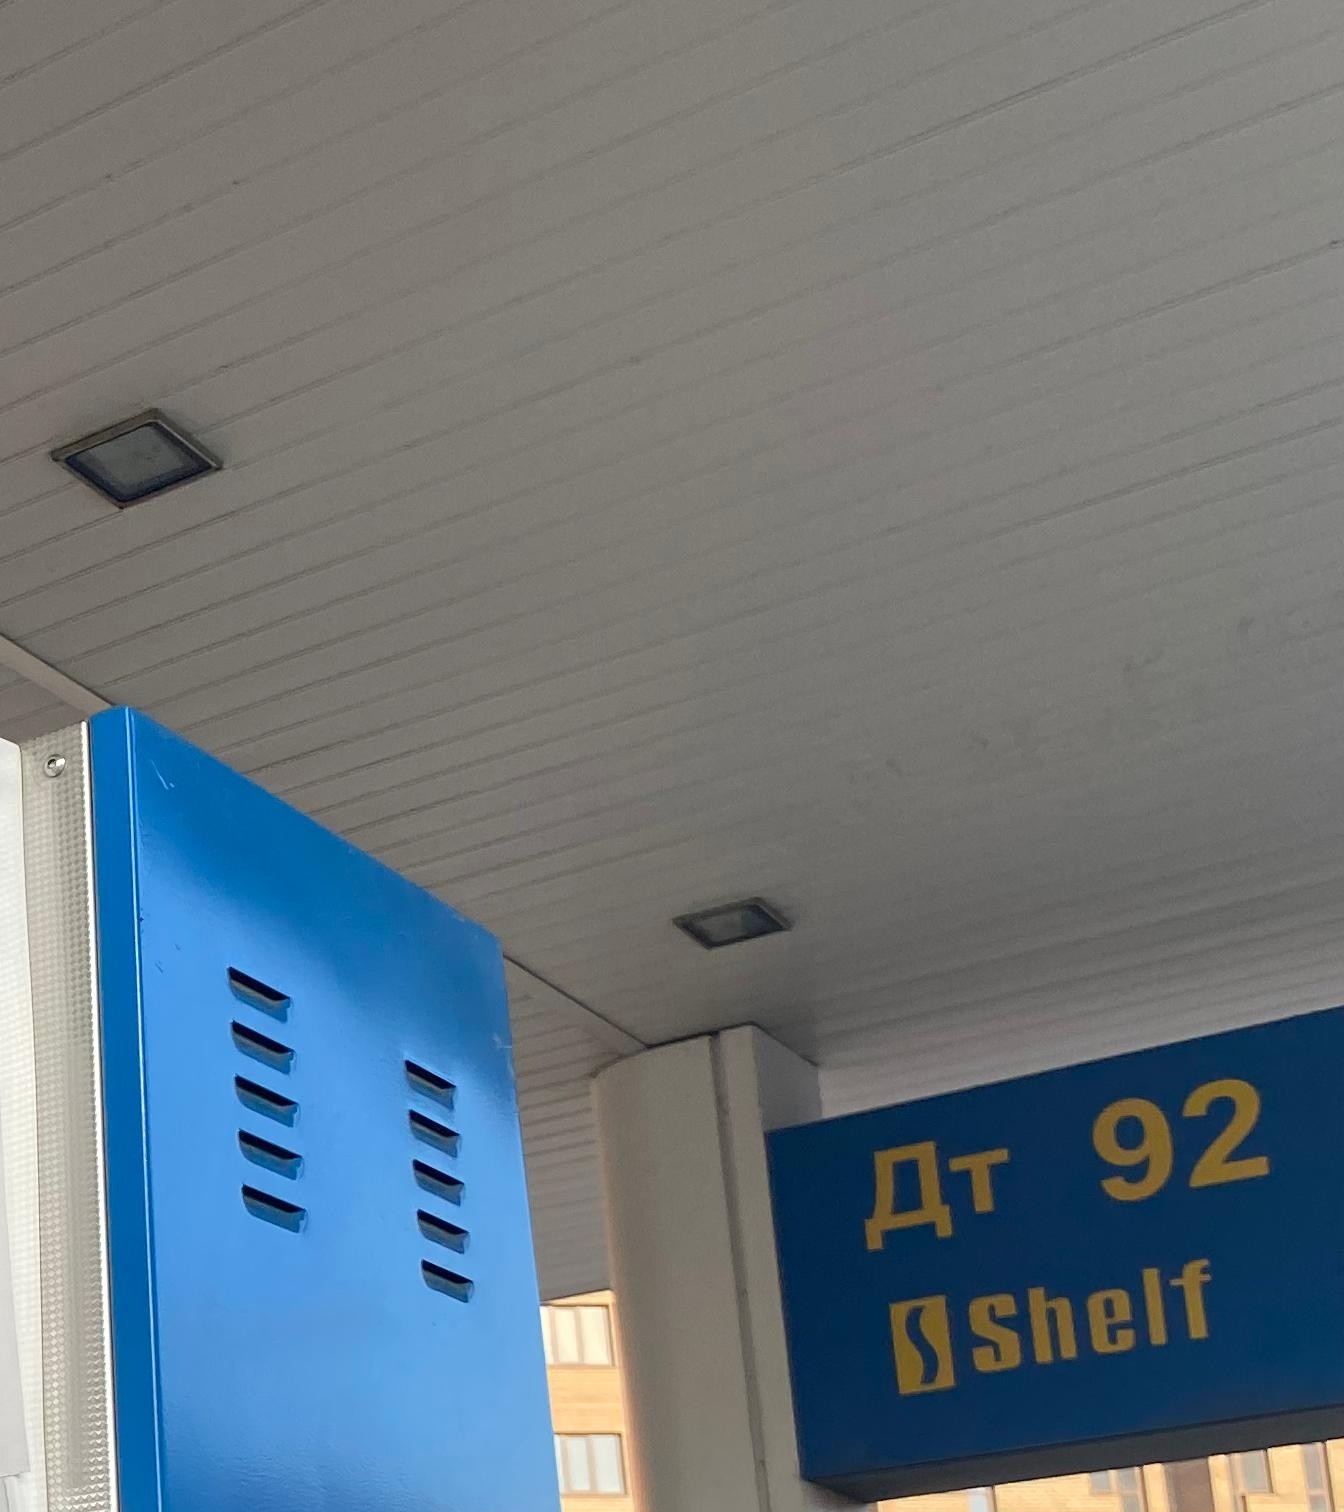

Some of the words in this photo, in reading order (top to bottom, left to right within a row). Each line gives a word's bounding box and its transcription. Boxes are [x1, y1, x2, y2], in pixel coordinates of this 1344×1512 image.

[864, 1140, 1012, 1252] Дт
[1090, 1078, 1271, 1204] 92
[968, 1257, 1214, 1374] Shelf
